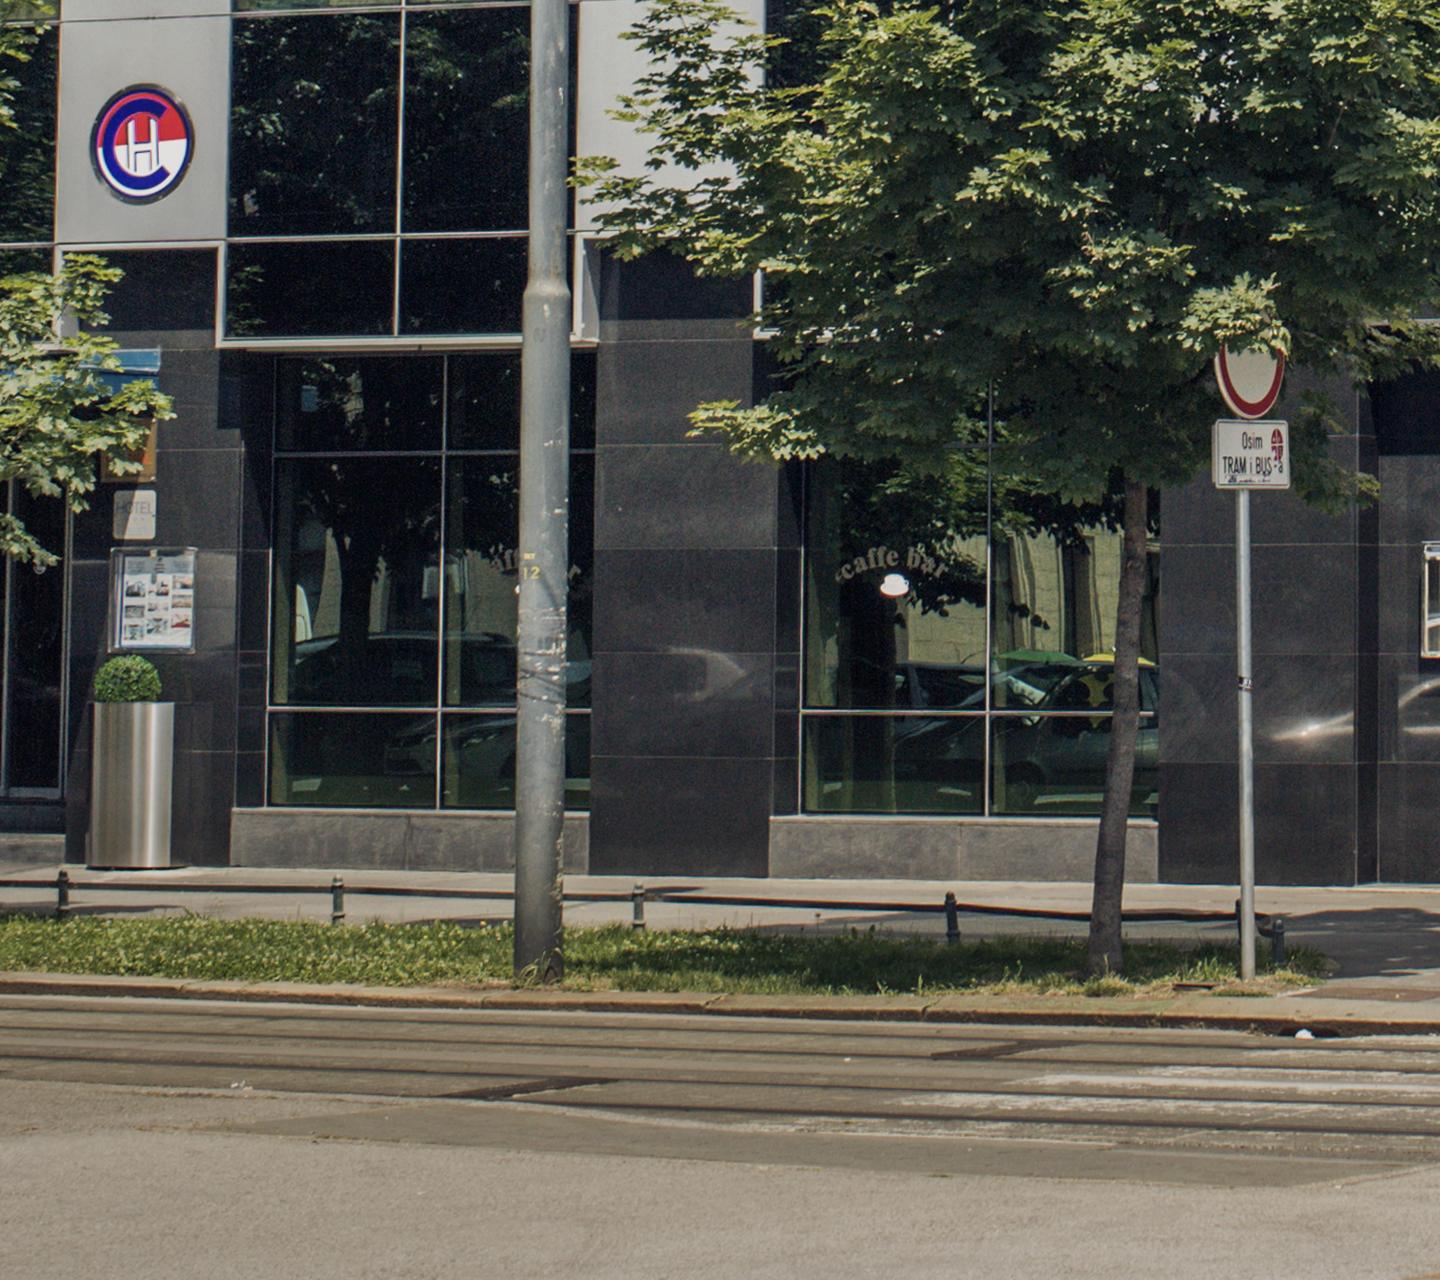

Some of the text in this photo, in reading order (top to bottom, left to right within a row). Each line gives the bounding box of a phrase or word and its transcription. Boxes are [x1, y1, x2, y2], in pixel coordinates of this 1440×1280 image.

[1241, 431, 1263, 450] Osim
[1222, 455, 1247, 475] TRAM
[840, 545, 900, 580] caffe
[523, 566, 541, 580] 12
